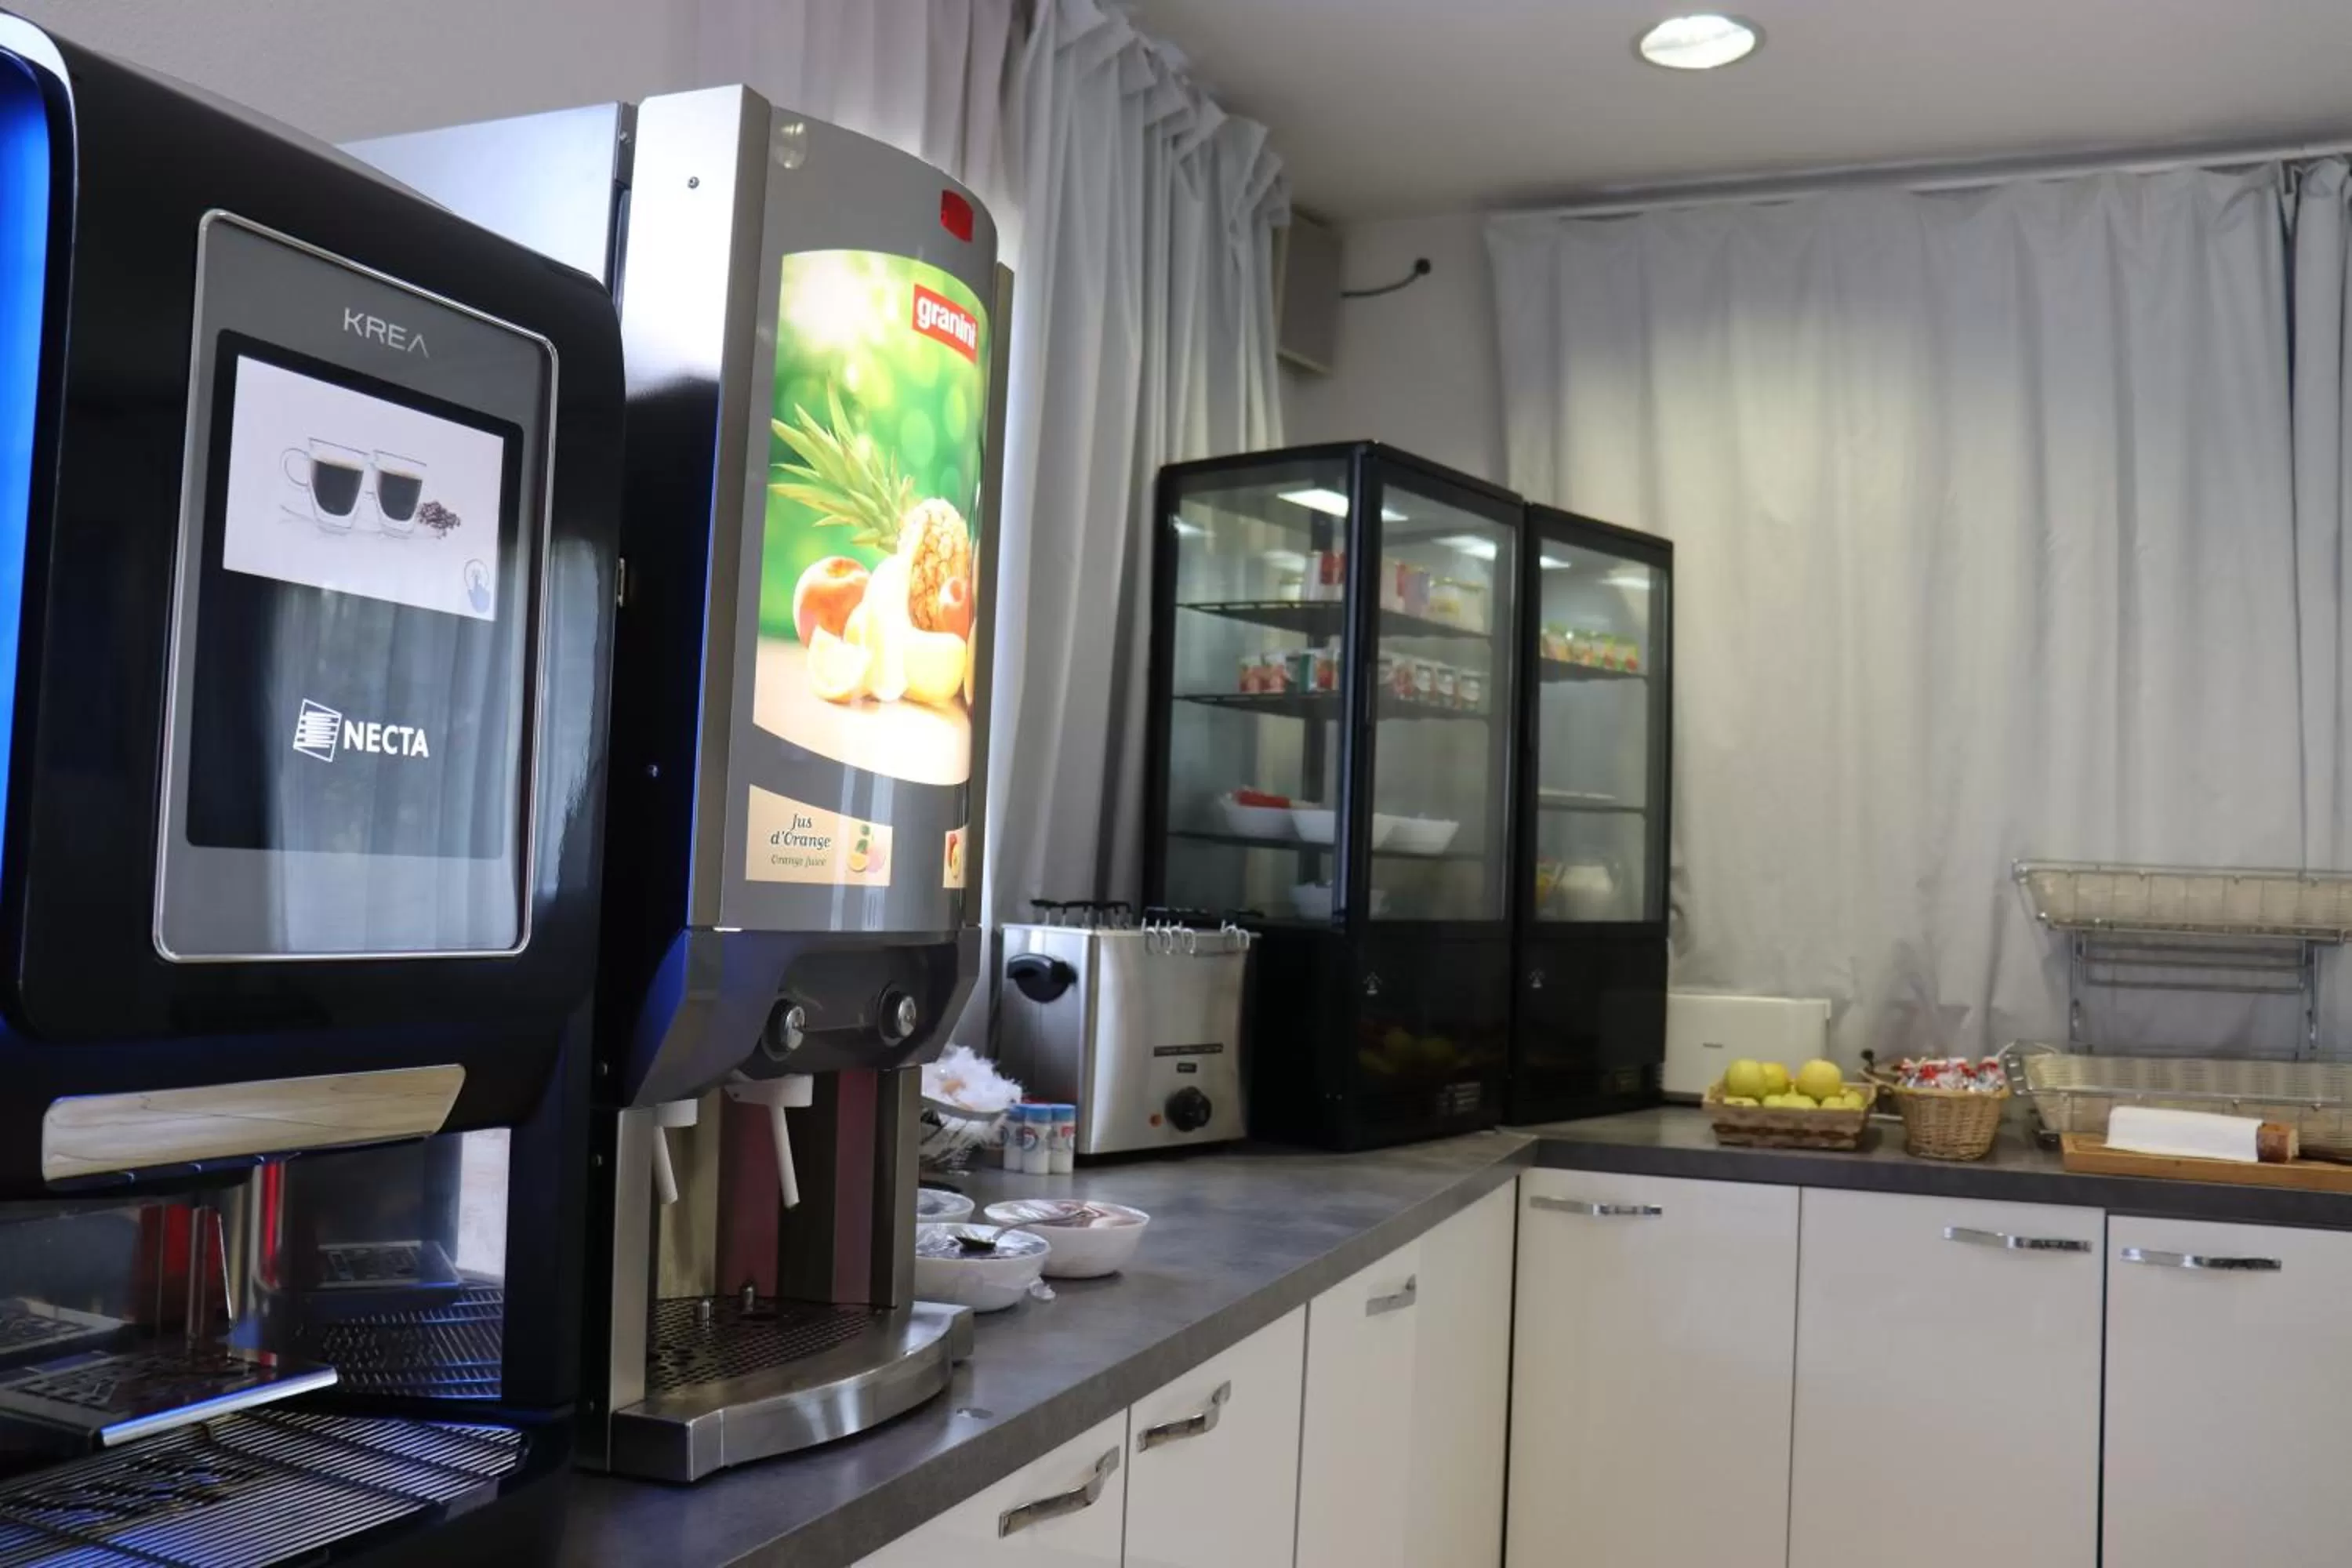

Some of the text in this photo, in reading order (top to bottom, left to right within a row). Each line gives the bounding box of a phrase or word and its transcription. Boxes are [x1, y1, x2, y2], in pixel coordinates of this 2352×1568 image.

[343, 307, 430, 358] KREA
[916, 296, 976, 350] granini
[343, 719, 430, 758] NECTA
[770, 830, 832, 851] d'Orange
[790, 813, 812, 831] Jus
